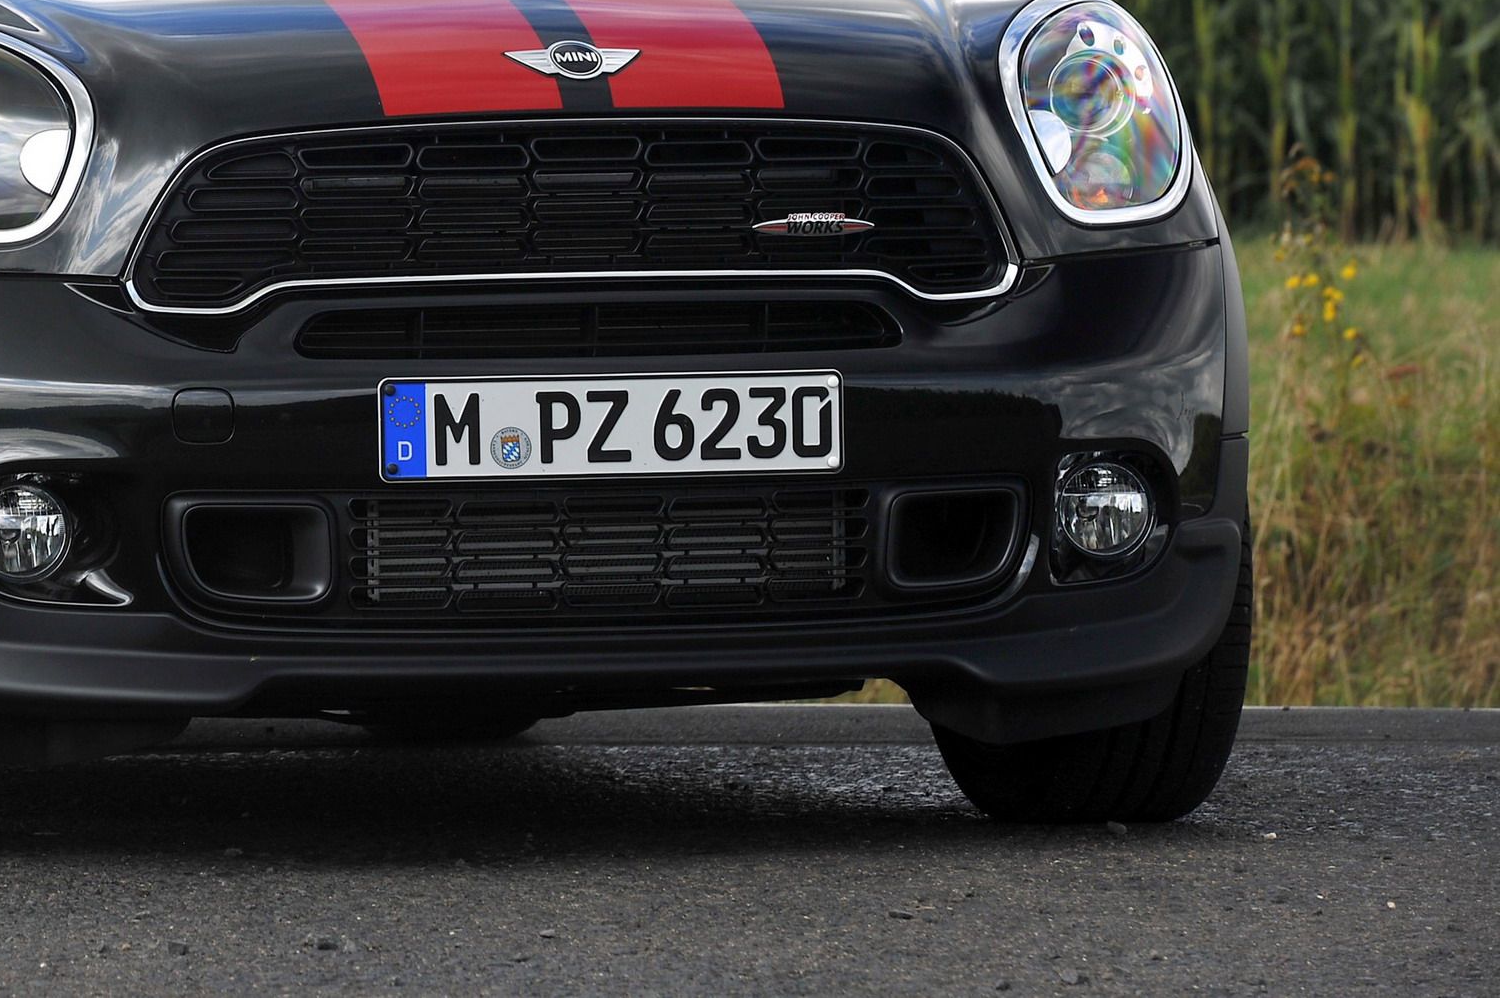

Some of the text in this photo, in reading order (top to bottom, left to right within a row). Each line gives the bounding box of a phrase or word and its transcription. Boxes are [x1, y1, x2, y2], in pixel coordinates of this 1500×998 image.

[555, 51, 598, 63] MINI
[787, 212, 845, 222] JOHN COOPER
[787, 220, 844, 234] WORKS
[433, 393, 481, 466] M
[535, 390, 632, 464] PZ
[653, 386, 833, 462] 6230
[398, 441, 412, 461] D
